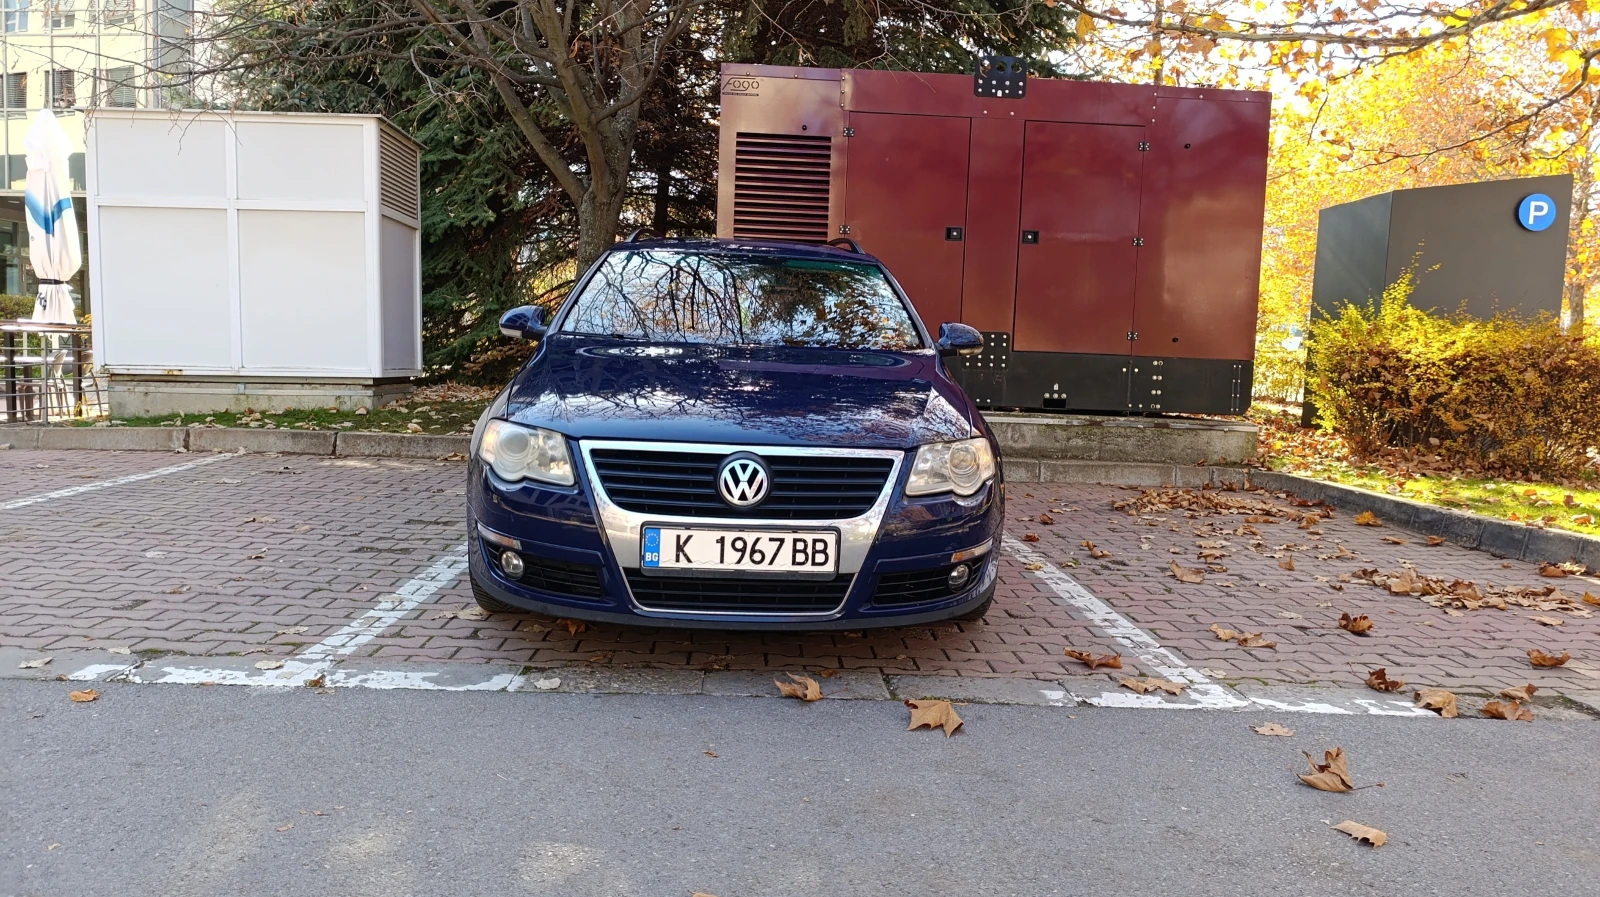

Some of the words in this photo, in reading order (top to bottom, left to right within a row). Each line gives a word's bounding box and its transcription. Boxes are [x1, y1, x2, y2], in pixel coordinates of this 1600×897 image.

[1528, 201, 1549, 225] P
[721, 460, 768, 505] VW
[645, 552, 659, 562] BG
[675, 534, 694, 563] K
